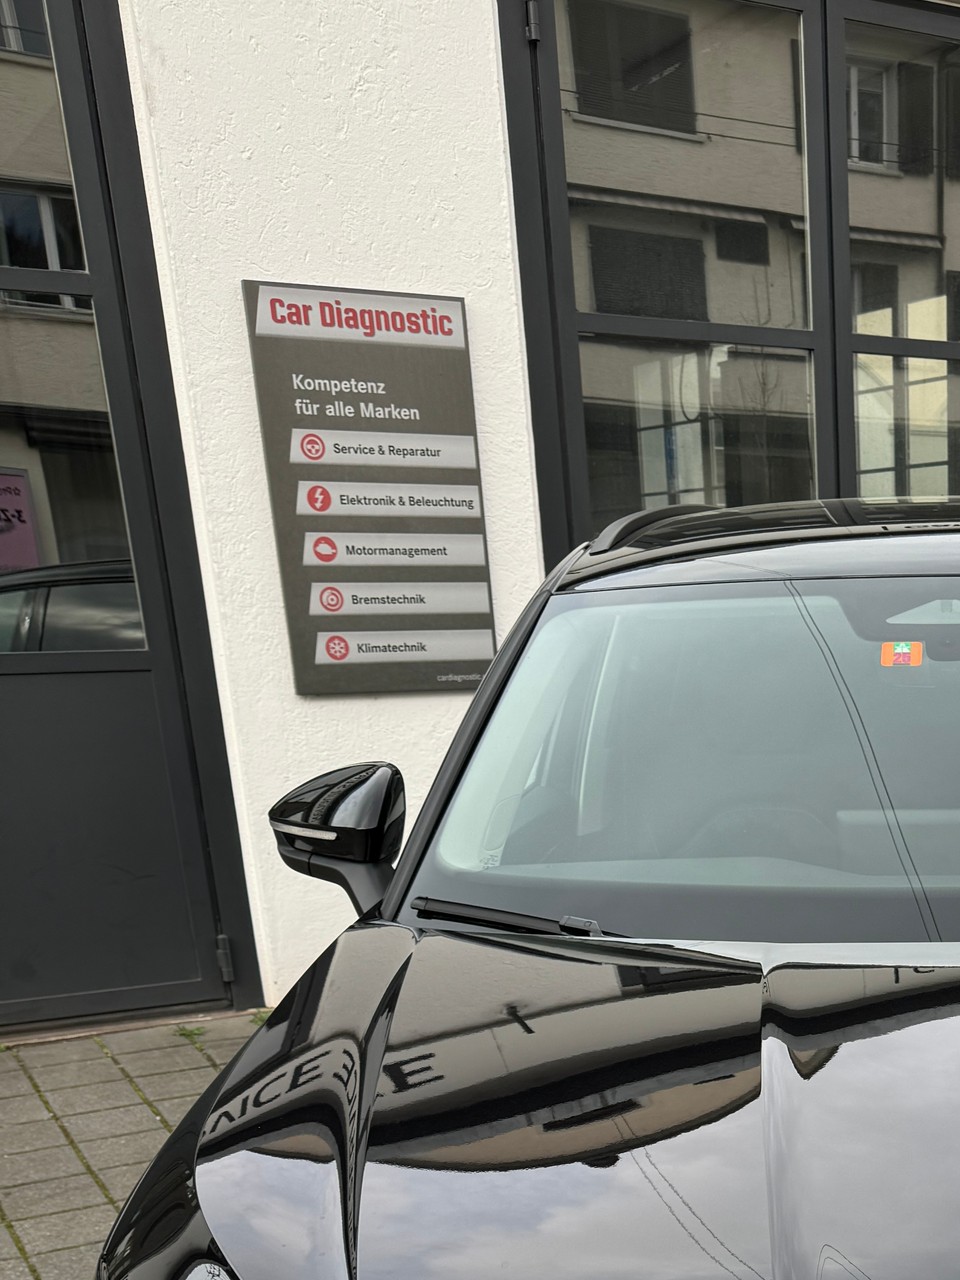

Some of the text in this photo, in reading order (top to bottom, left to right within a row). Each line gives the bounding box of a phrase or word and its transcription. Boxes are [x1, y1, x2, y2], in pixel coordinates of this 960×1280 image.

[269, 297, 453, 337] Car Diagnostic
[292, 373, 386, 395] Kompetenz
[295, 399, 420, 420] für alle Marken
[333, 443, 441, 459] Service & Reparatur
[339, 494, 474, 510] Elektronik & Beleuchtung
[345, 545, 448, 558] Motormanagement
[351, 594, 426, 605] Bremstechnik
[356, 643, 427, 653] Klimatechnik
